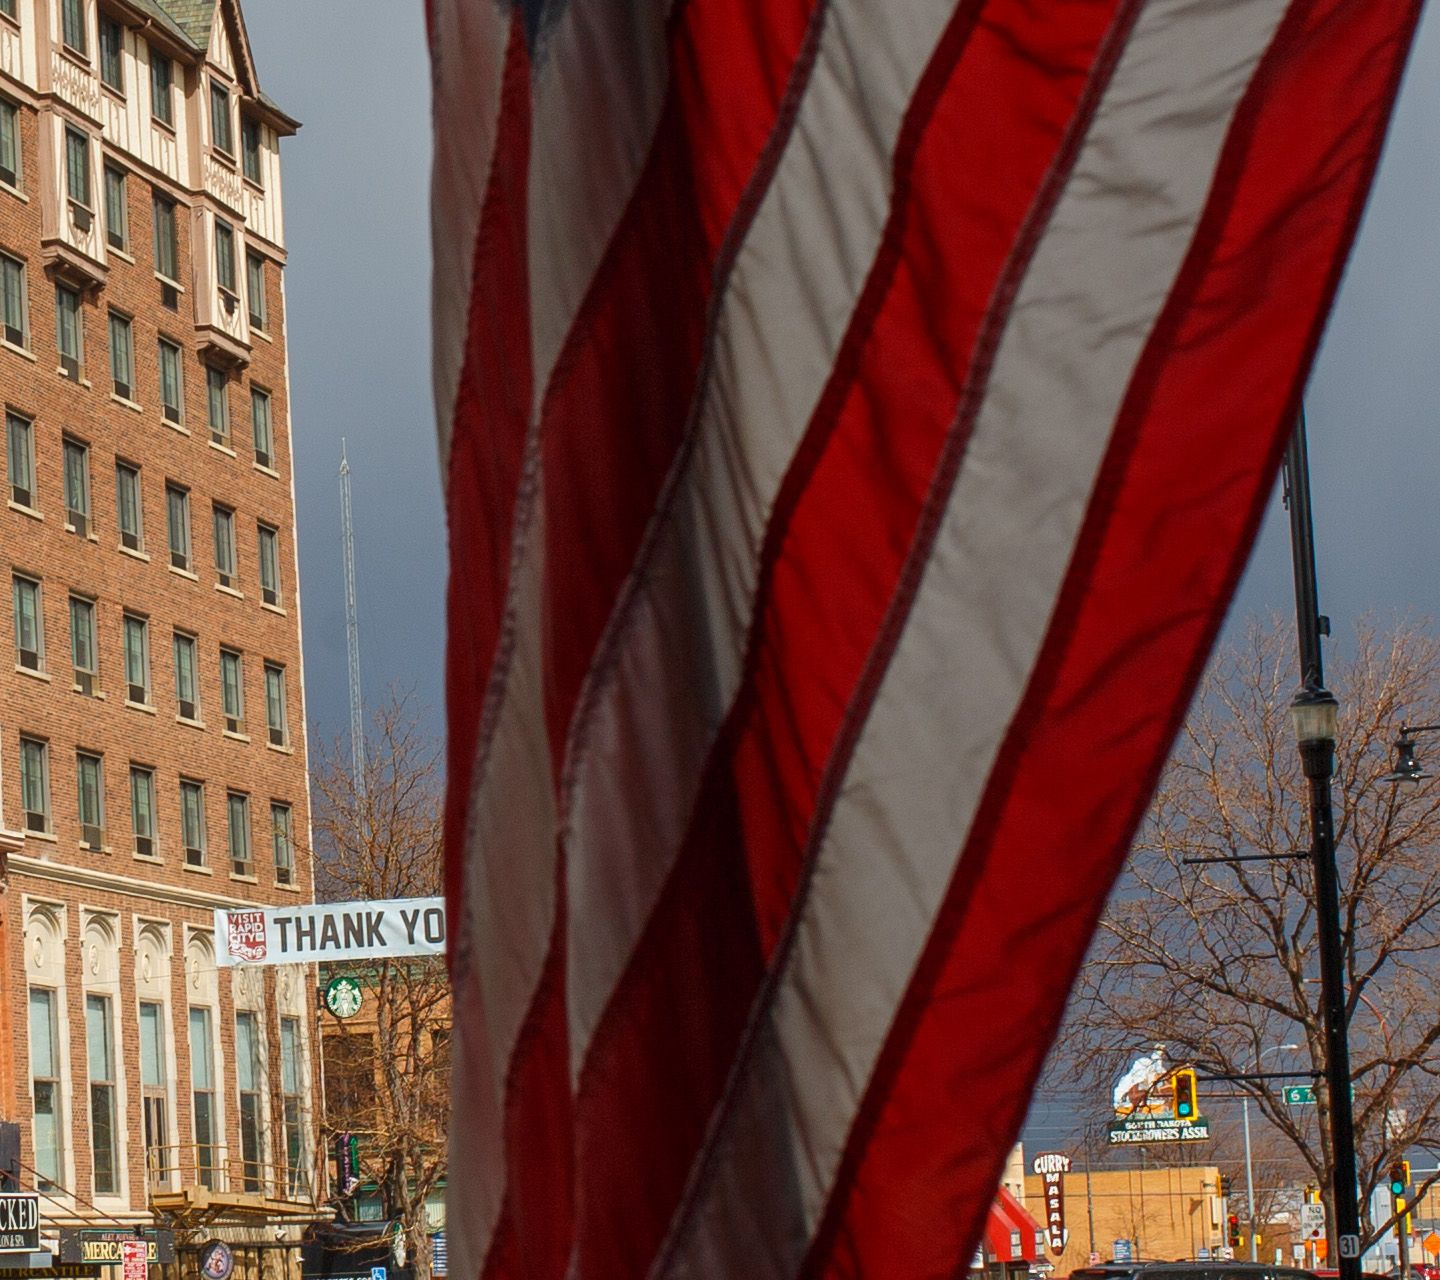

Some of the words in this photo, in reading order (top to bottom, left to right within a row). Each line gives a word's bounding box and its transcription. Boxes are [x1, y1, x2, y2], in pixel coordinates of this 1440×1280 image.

[230, 912, 262, 924] VISIT
[229, 923, 263, 933] RAPID
[274, 911, 387, 952] THANK
[400, 907, 445, 945] YO
[229, 933, 255, 943] CITY
[1034, 1154, 1069, 1173] CURRY
[1046, 1173, 1062, 1247] MASALA
[15, 1235, 25, 1246] SPA
[1340, 1237, 1357, 1255] 31
[83, 1241, 157, 1260] MERCAE
